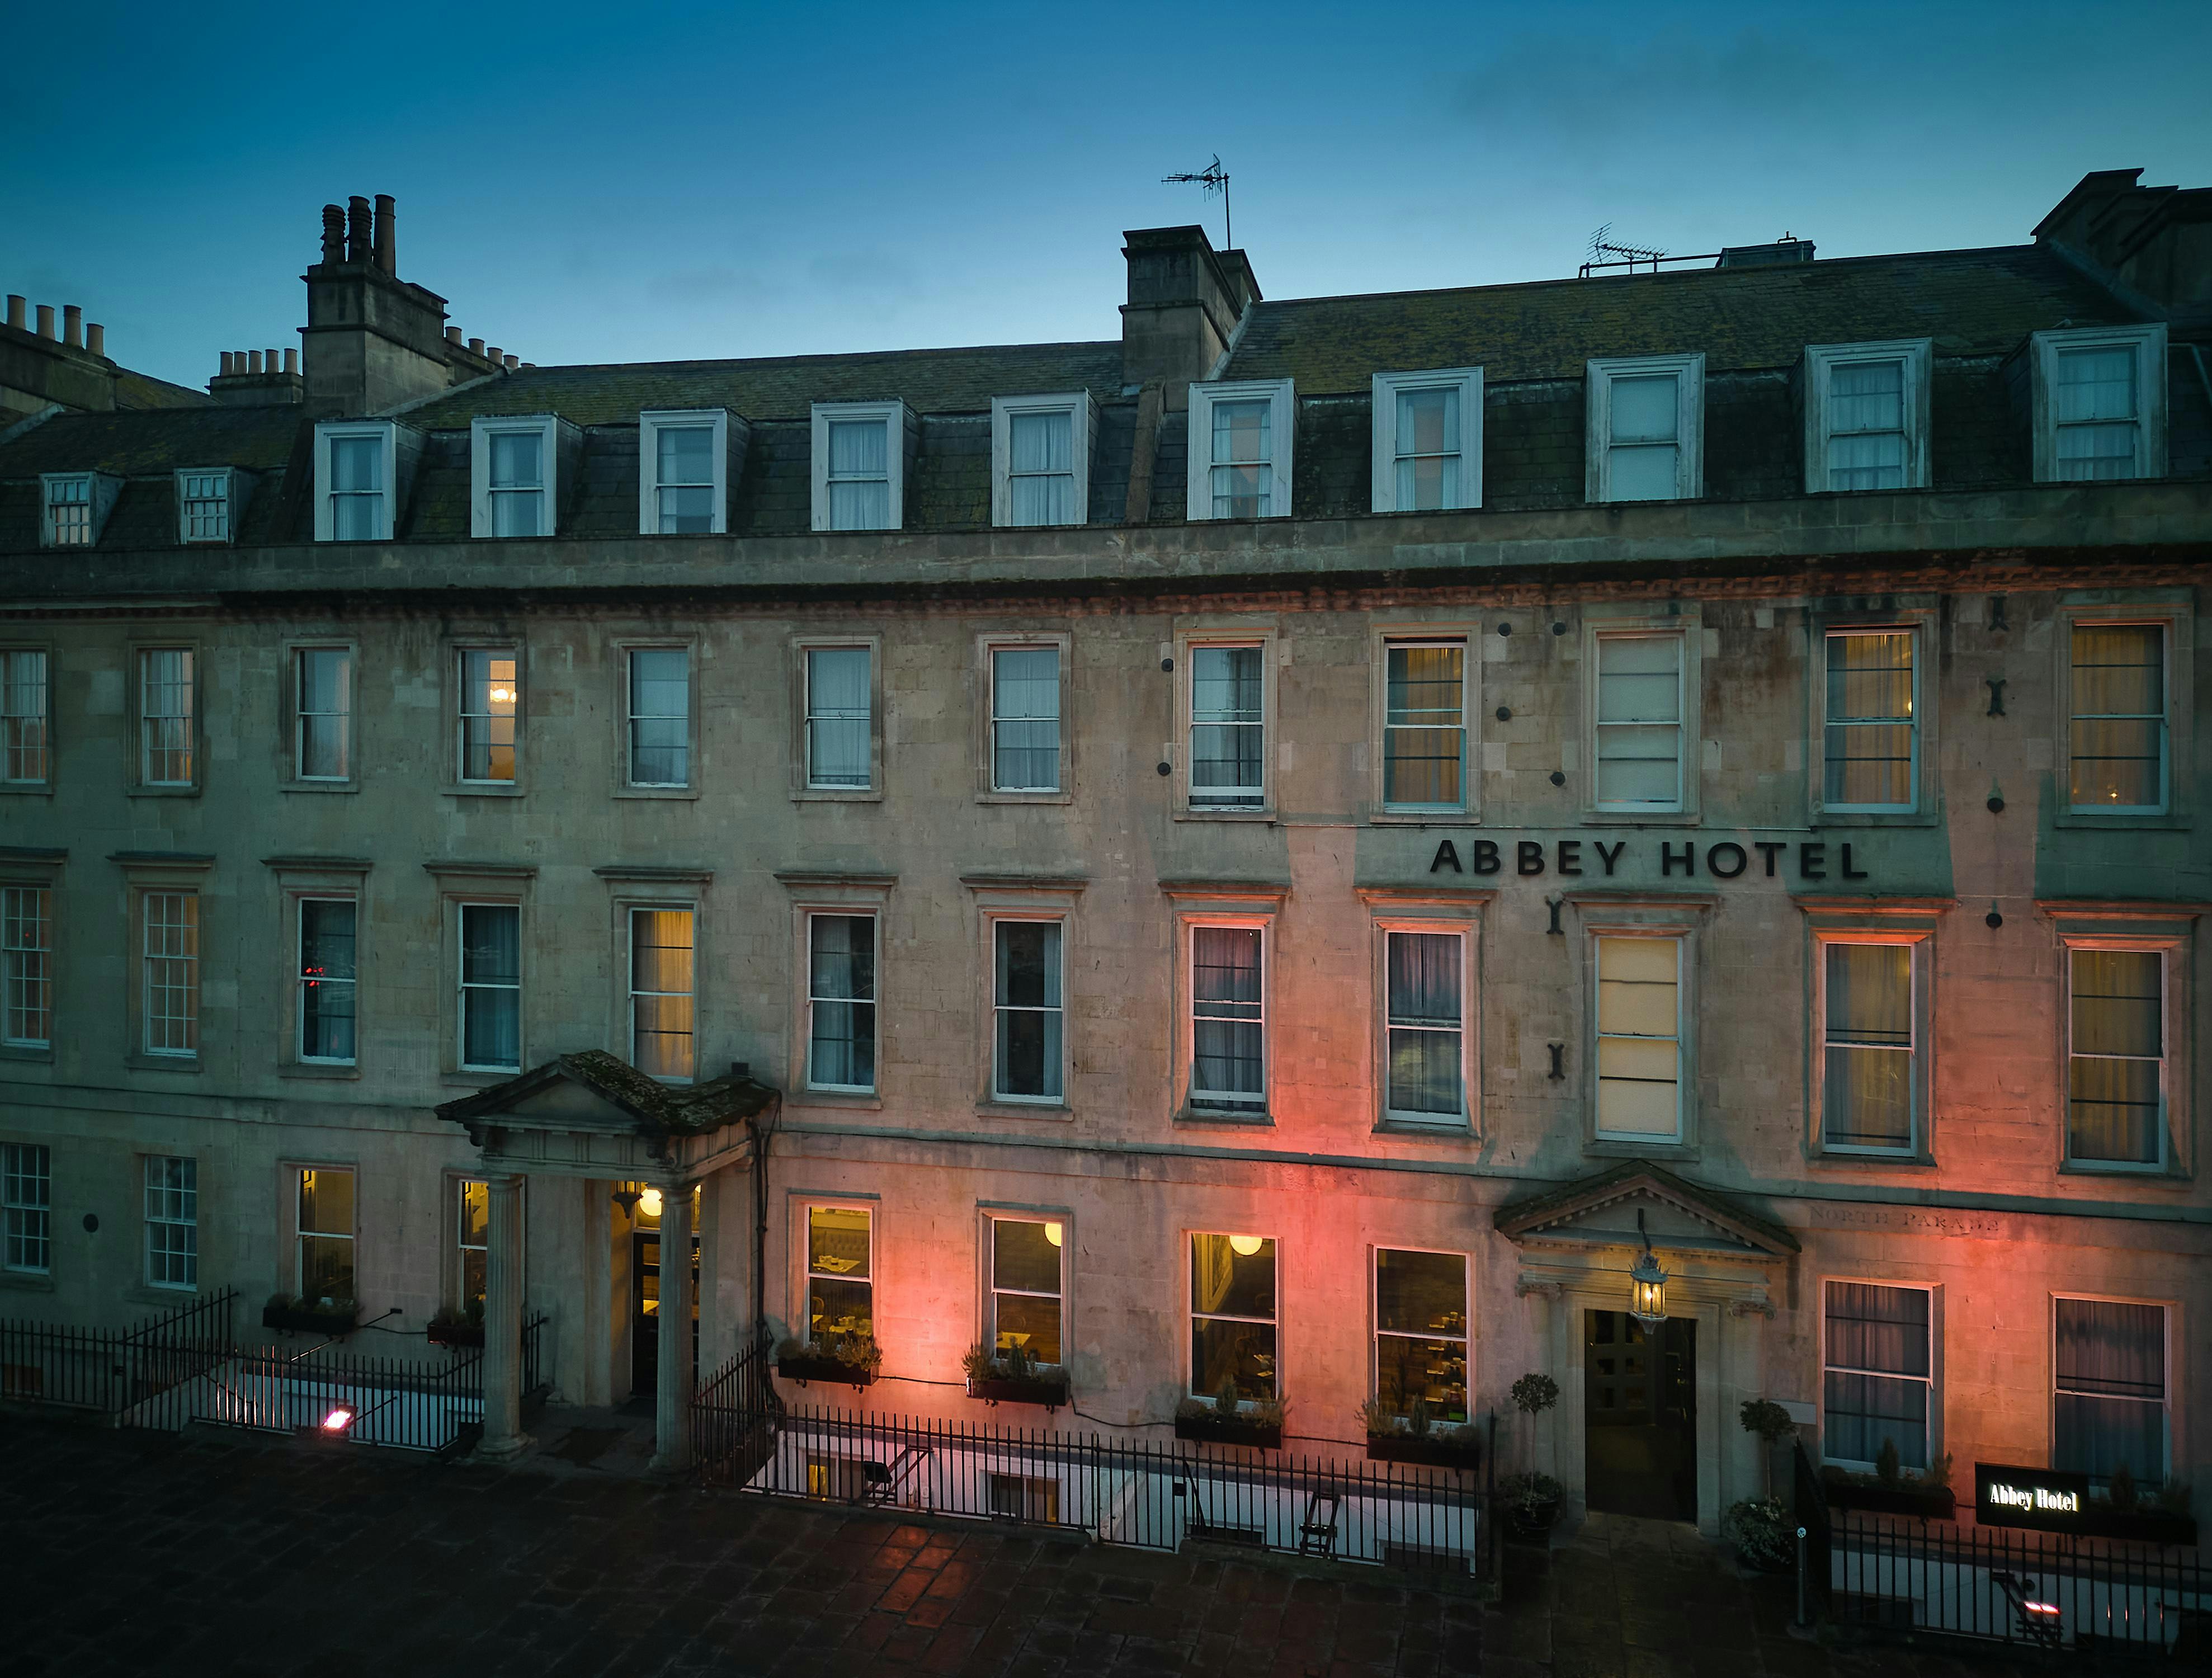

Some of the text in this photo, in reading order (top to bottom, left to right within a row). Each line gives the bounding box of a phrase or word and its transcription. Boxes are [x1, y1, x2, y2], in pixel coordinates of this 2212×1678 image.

[1430, 839, 1868, 878] ABBEY HOTEL
[1810, 1206, 1889, 1224] NORTH
[1990, 1484, 2078, 1512] Abbey Hotel
